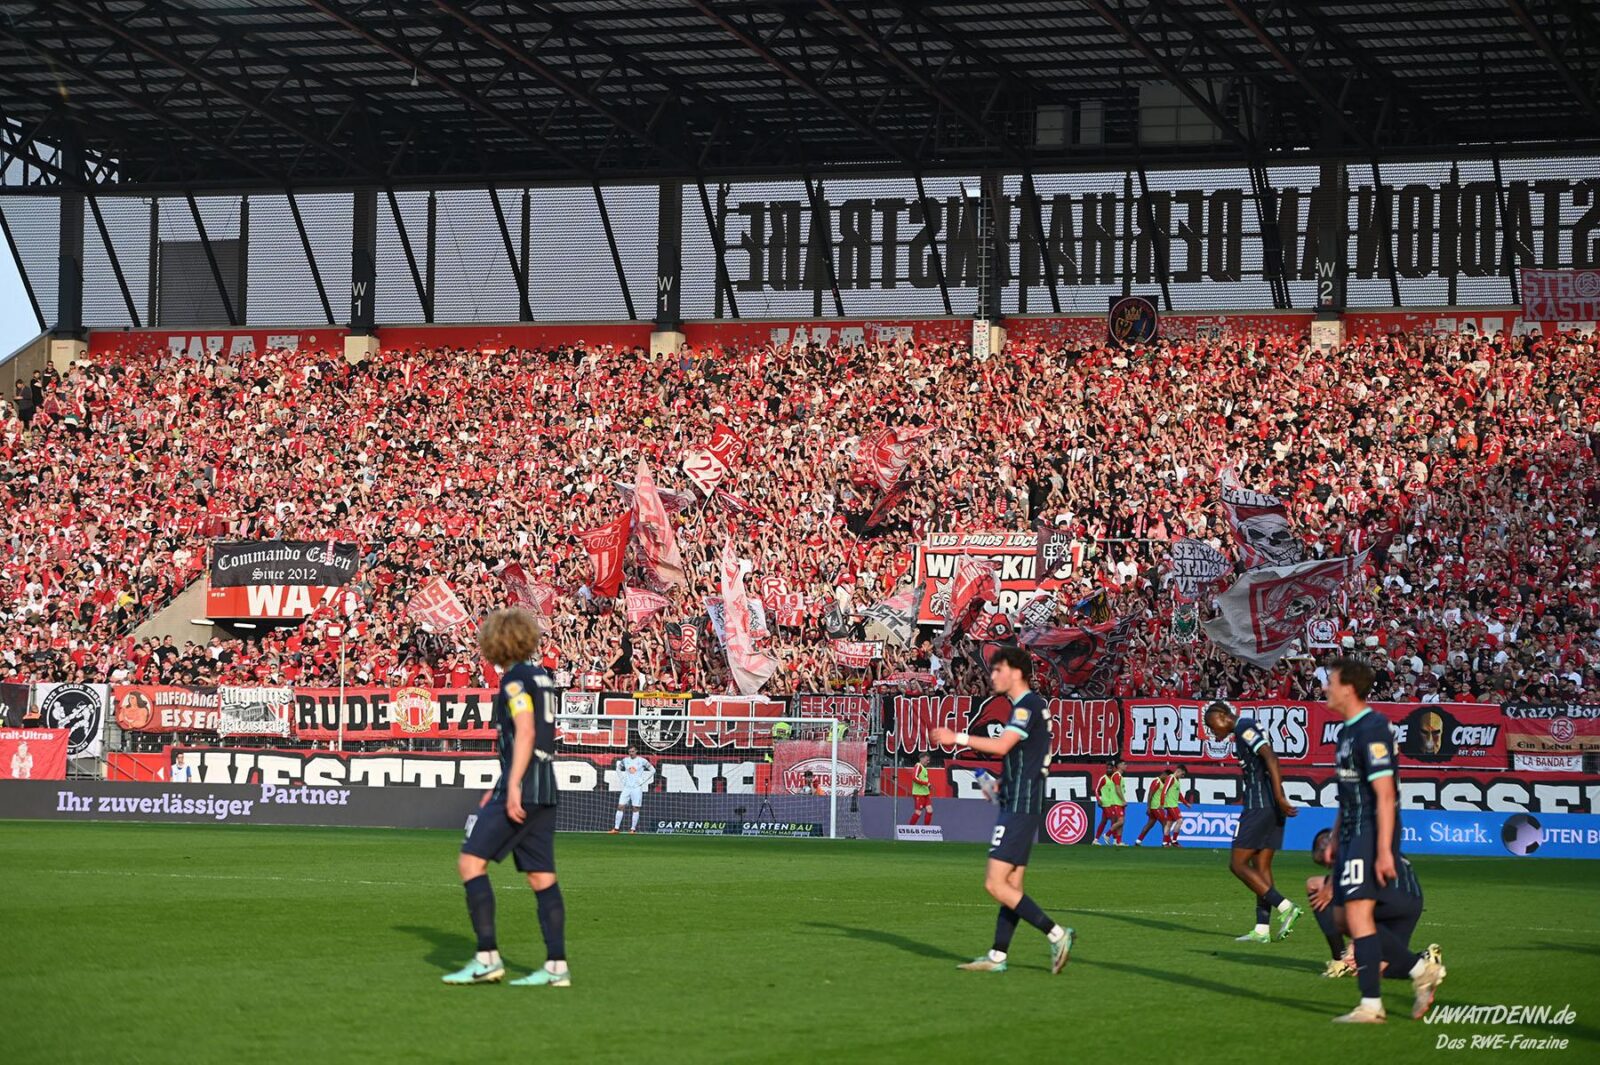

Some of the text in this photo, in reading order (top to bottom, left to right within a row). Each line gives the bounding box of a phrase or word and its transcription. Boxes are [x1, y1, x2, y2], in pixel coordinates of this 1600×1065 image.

[933, 534, 960, 546] LOS
[218, 546, 301, 571] Commando
[252, 568, 317, 580] Since 2012
[155, 691, 218, 708] HAFENSÄNGE
[161, 709, 218, 729] ESSEN
[299, 695, 391, 731] RUDE
[886, 694, 972, 754] JUNGE
[0, 730, 54, 741] ralt-Ultras
[1451, 726, 1497, 746] CREW
[57, 783, 350, 820] Ihr zuverlässiger Partner
[658, 820, 726, 830] GARTENBAU
[743, 822, 813, 832] GARTENBAU
[1430, 821, 1494, 844] Stark.
[1541, 828, 1583, 844] UTEN
[1340, 858, 1364, 886] 20
